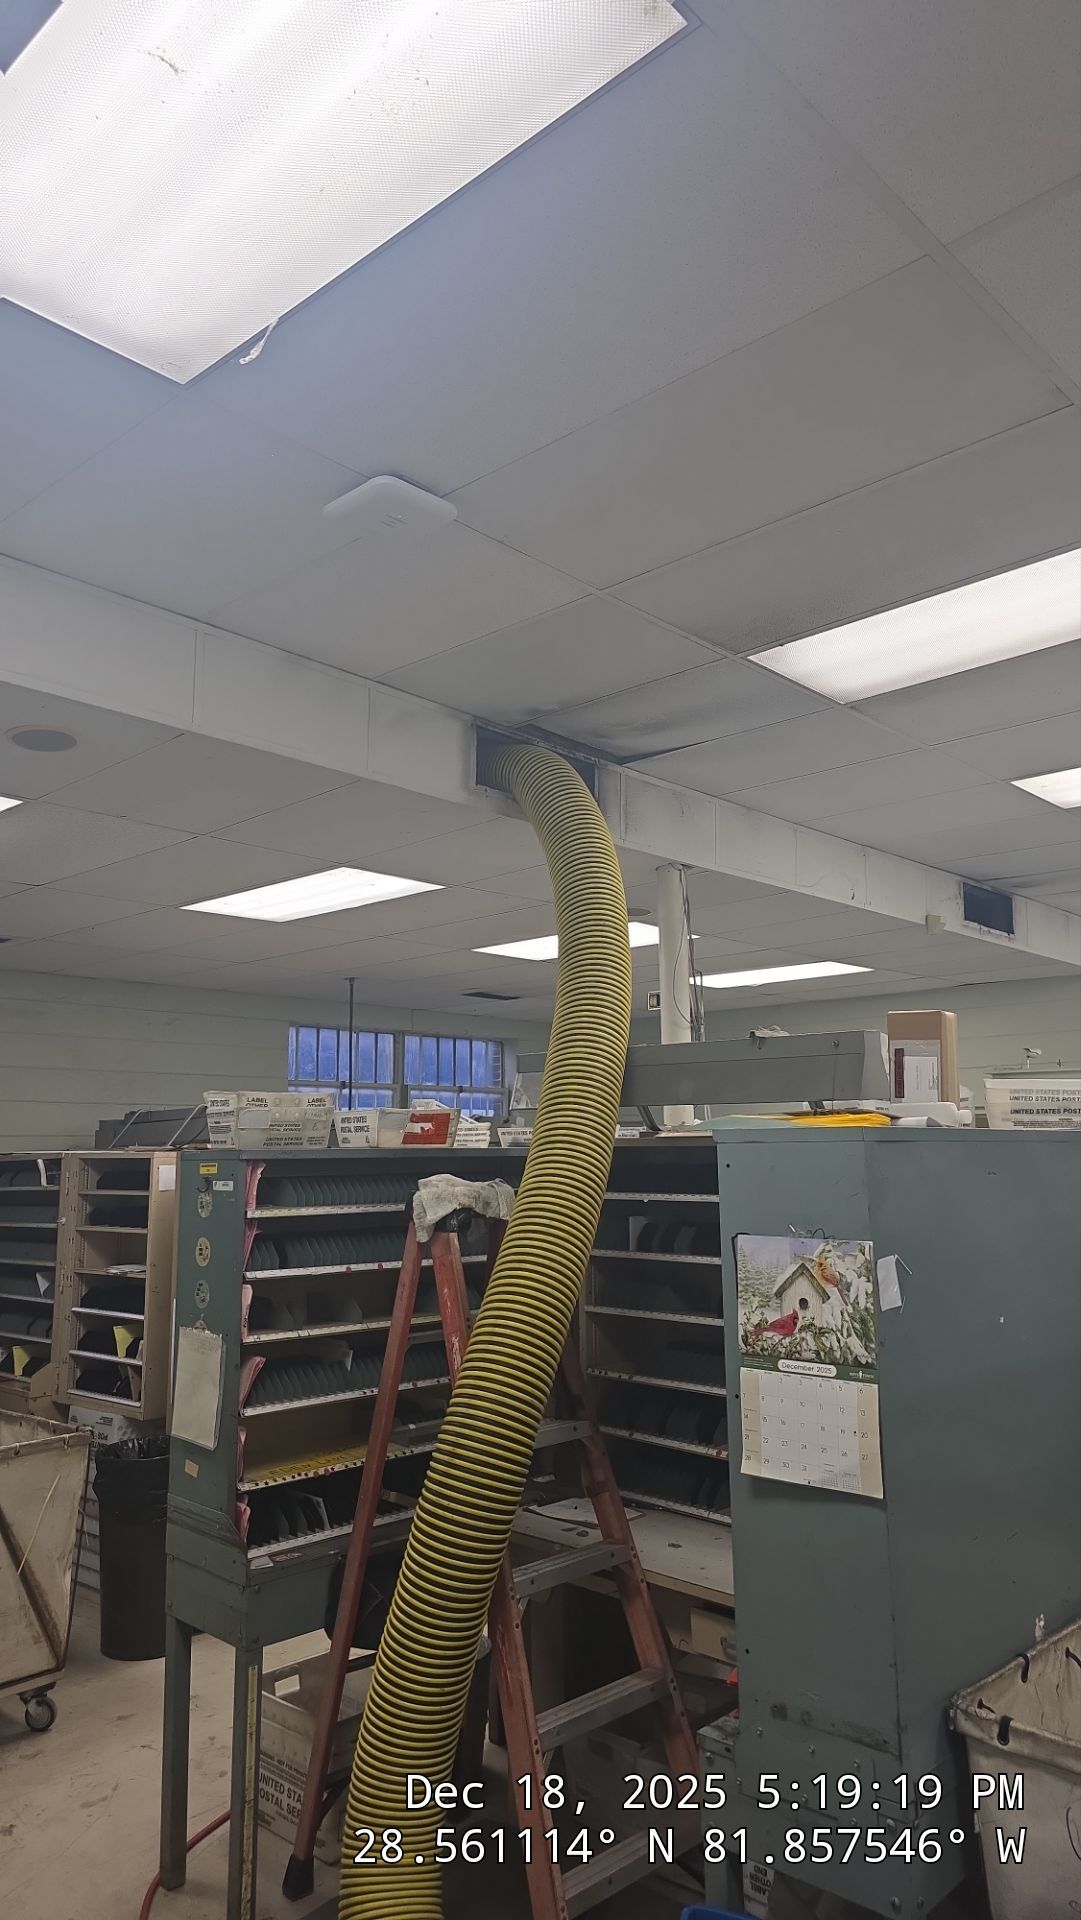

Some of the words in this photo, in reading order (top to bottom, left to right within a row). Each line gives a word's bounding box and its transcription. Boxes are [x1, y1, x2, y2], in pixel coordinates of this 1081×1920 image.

[782, 1362, 814, 1372] December
[816, 1366, 832, 1374] 2025
[260, 1788, 284, 1812] OSTAL
